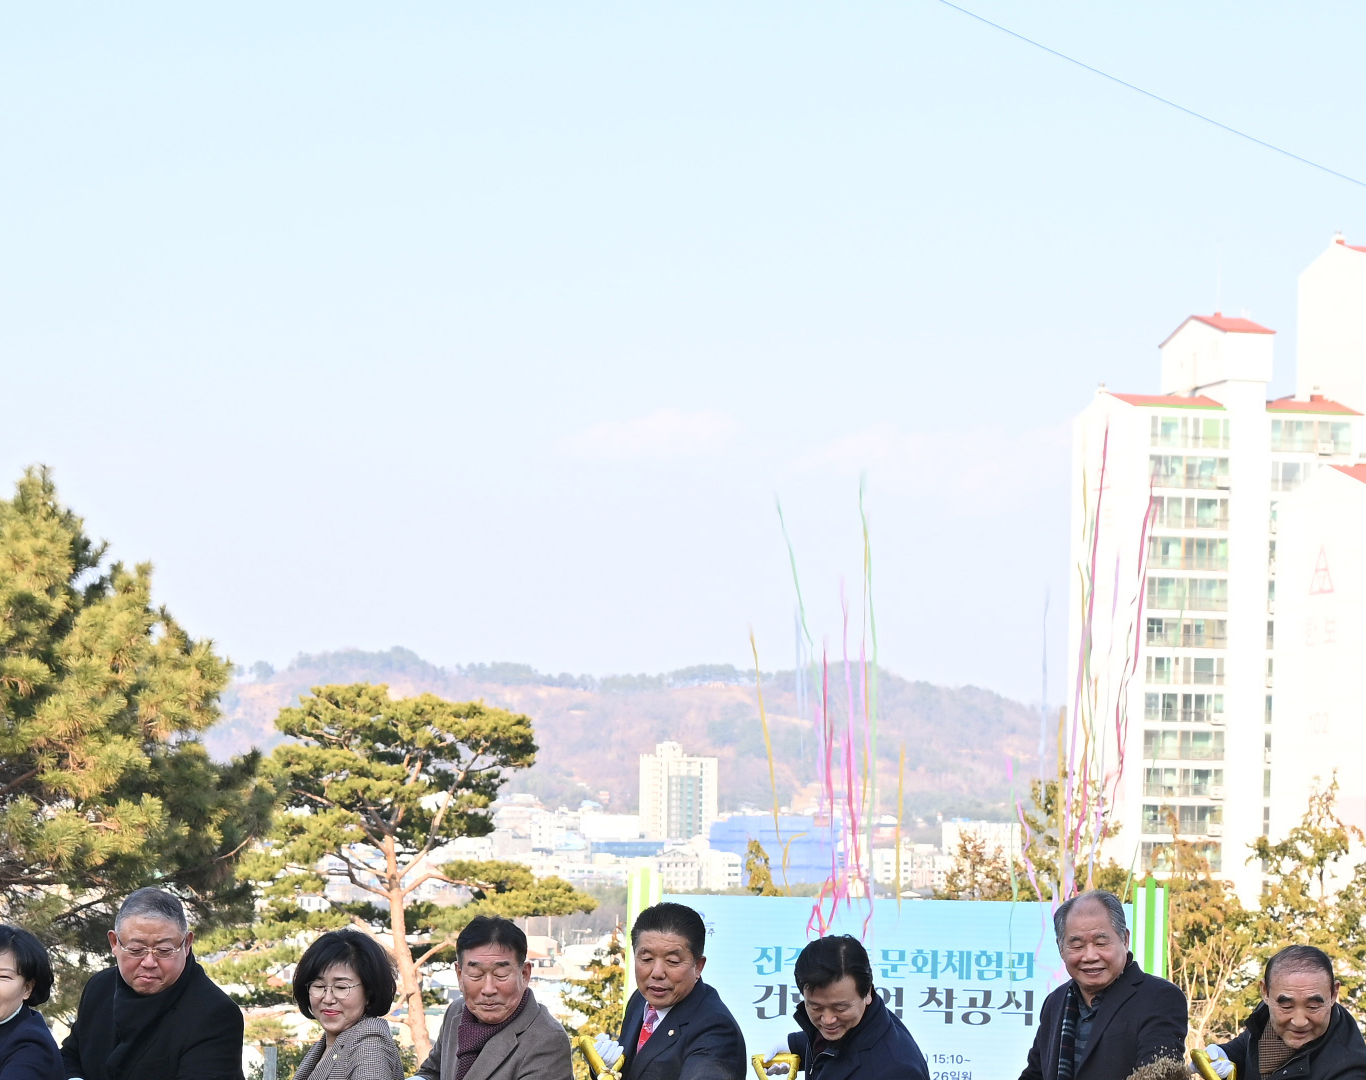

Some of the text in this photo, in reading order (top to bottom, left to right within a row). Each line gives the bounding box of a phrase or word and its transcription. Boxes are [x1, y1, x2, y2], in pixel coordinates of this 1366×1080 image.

[1308, 711, 1330, 735] 102
[918, 986, 1034, 1026] 착공식
[932, 1053, 971, 1065] 15:10~
